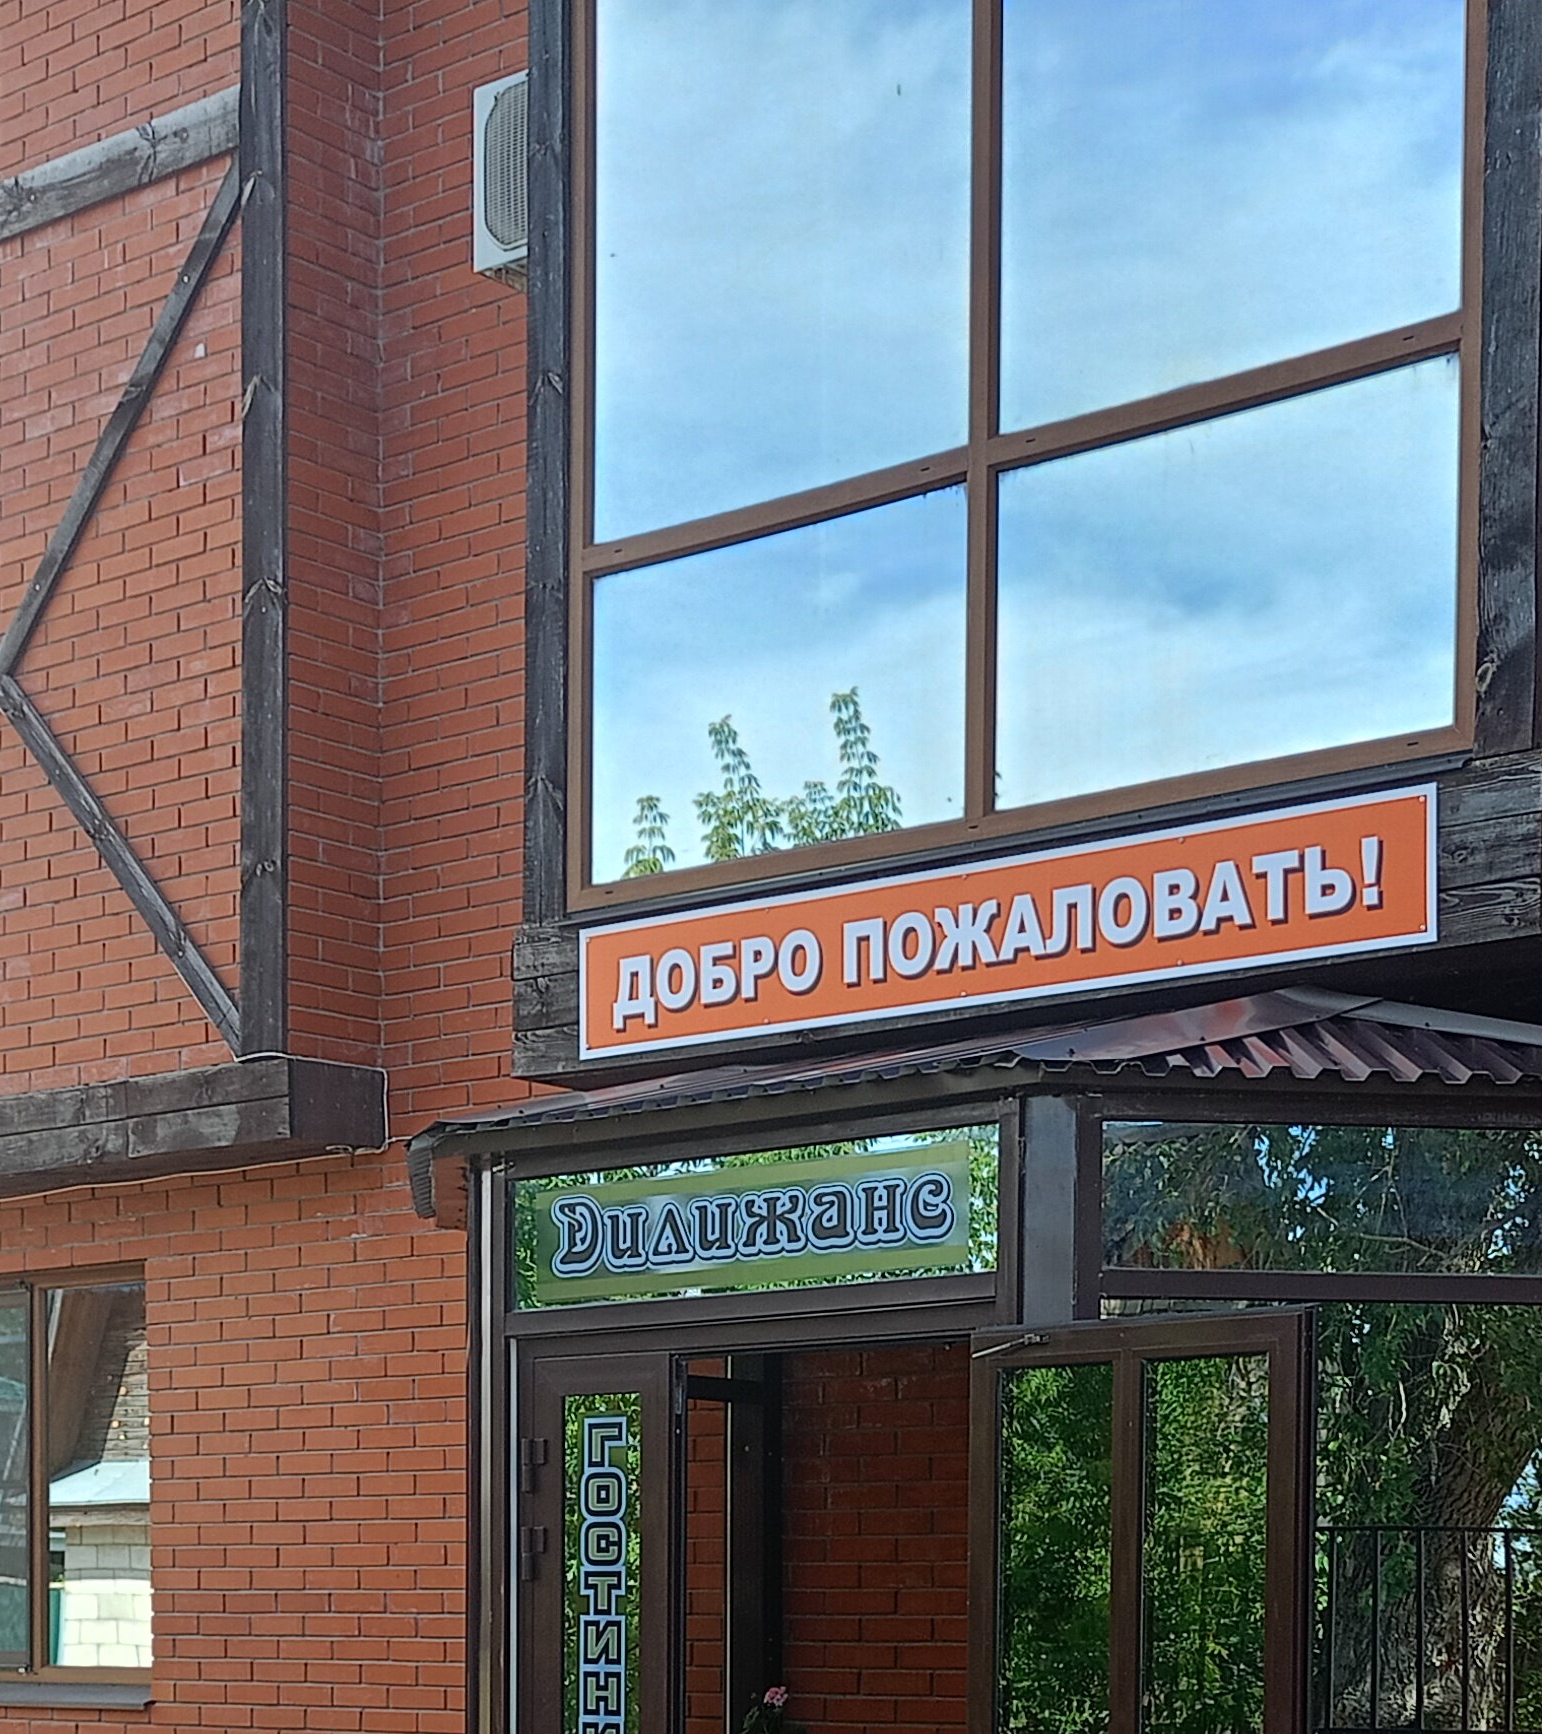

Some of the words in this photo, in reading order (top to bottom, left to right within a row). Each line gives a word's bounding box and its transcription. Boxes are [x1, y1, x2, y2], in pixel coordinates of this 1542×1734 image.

[612, 928, 822, 1030] ДОБРО
[843, 836, 1383, 985] ПОЖАЛОВАТЬ!
[552, 1171, 956, 1277] Дилижанс
